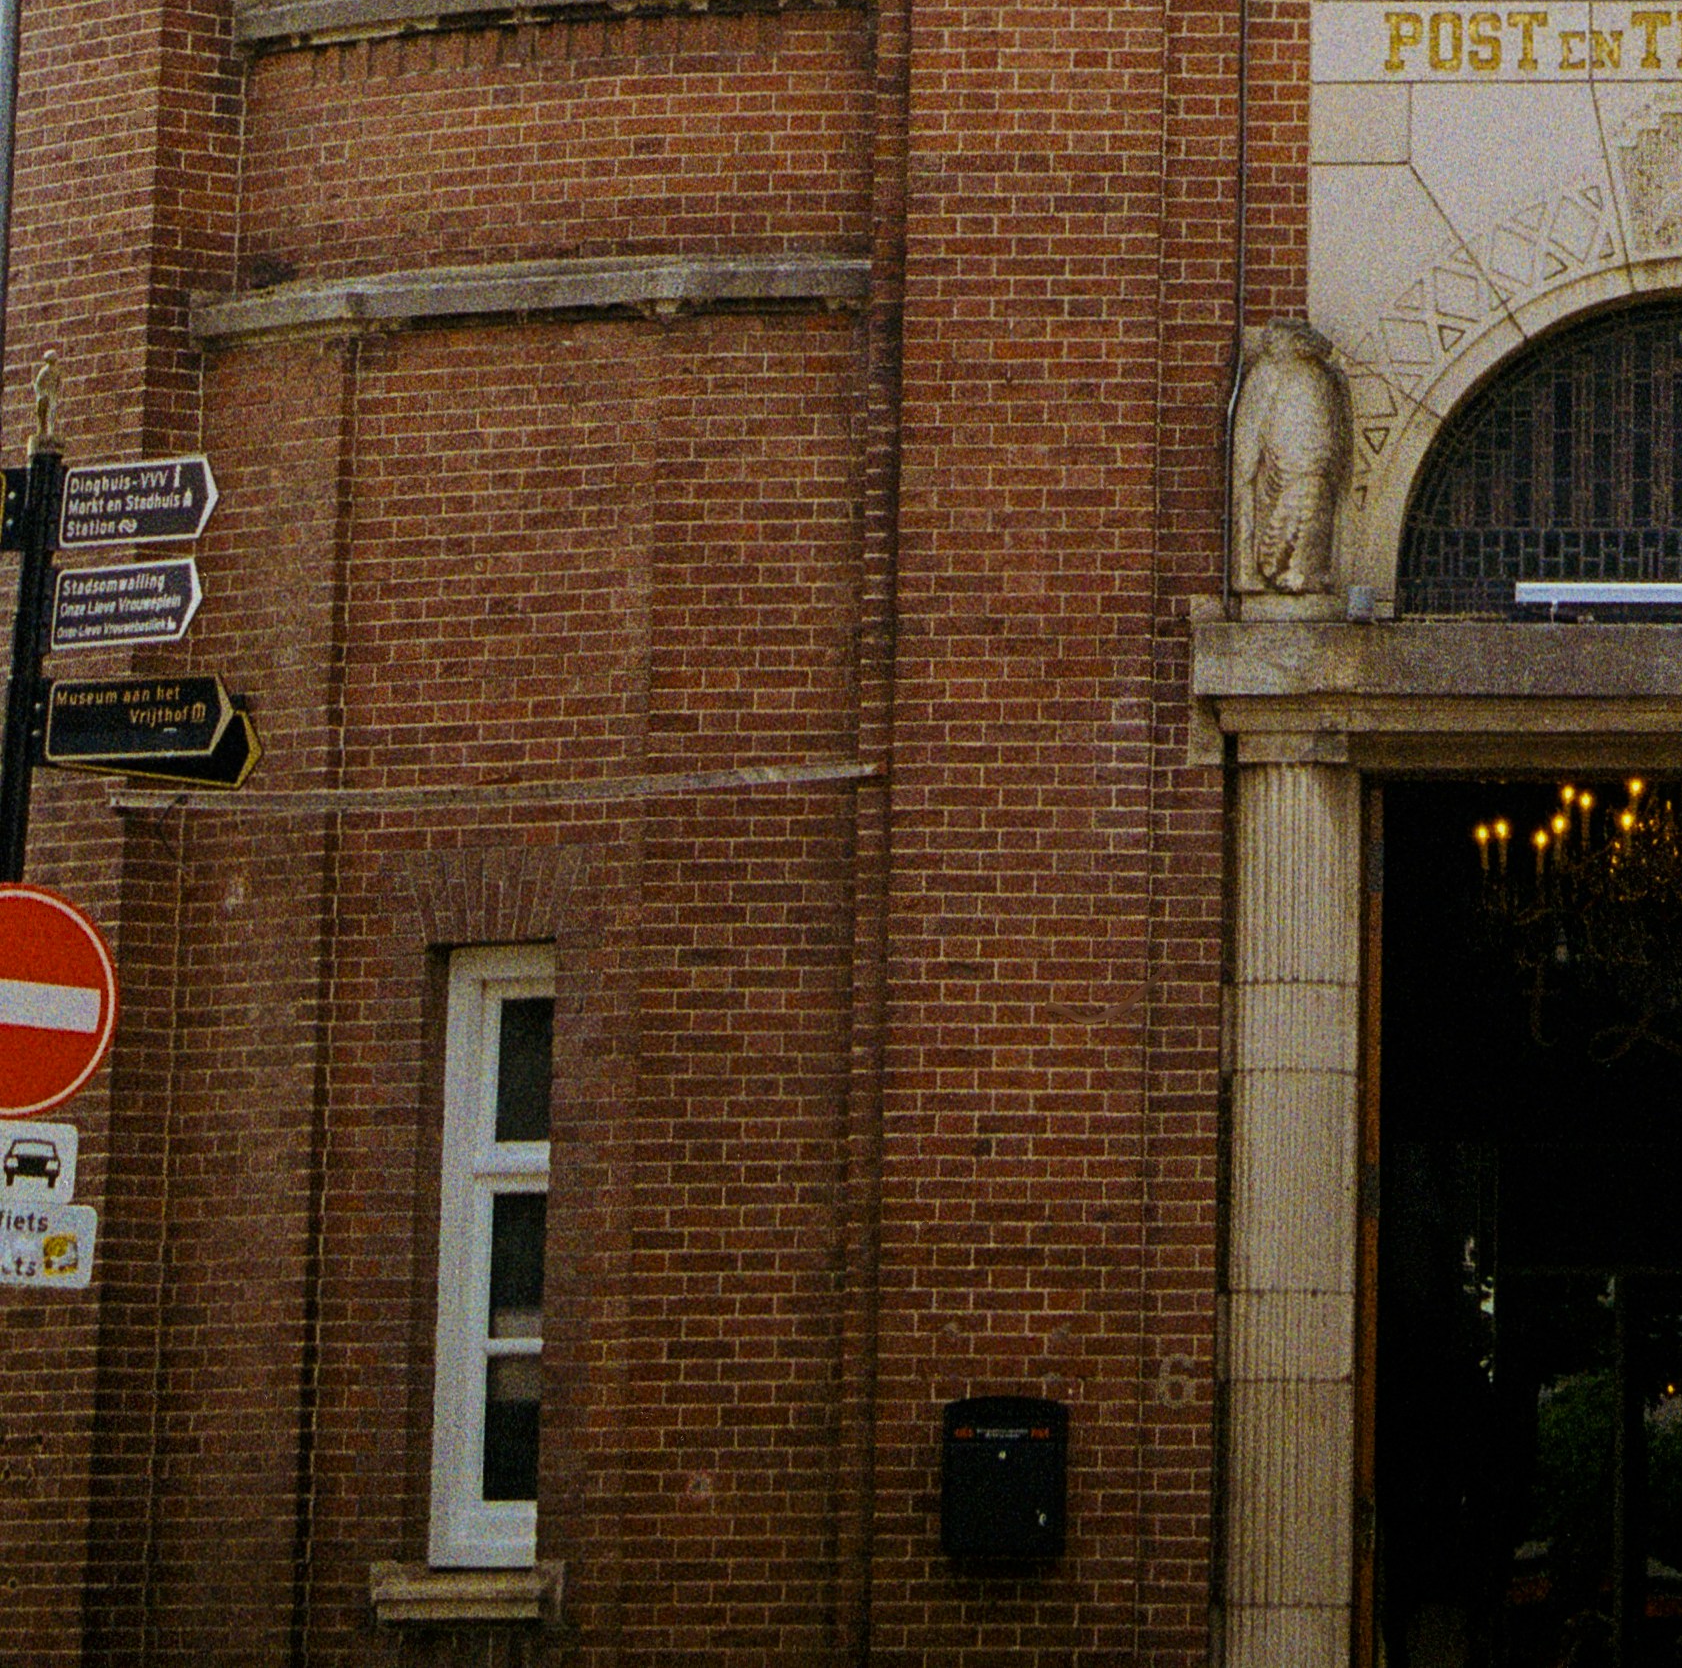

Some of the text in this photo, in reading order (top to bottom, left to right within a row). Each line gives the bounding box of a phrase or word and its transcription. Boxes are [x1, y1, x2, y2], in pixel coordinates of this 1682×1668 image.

[1383, 10, 1549, 72] POST
[1558, 28, 1625, 70] EN
[68, 493, 180, 515] Markt en Stadhuis
[66, 520, 116, 538] Station
[62, 573, 166, 596] Stadsomwalling
[60, 603, 86, 618] Onze
[87, 600, 117, 615] Lieve
[56, 685, 181, 706] Museum aan het
[129, 705, 189, 728] Vrijthof
[1157, 1353, 1196, 1409] 6
